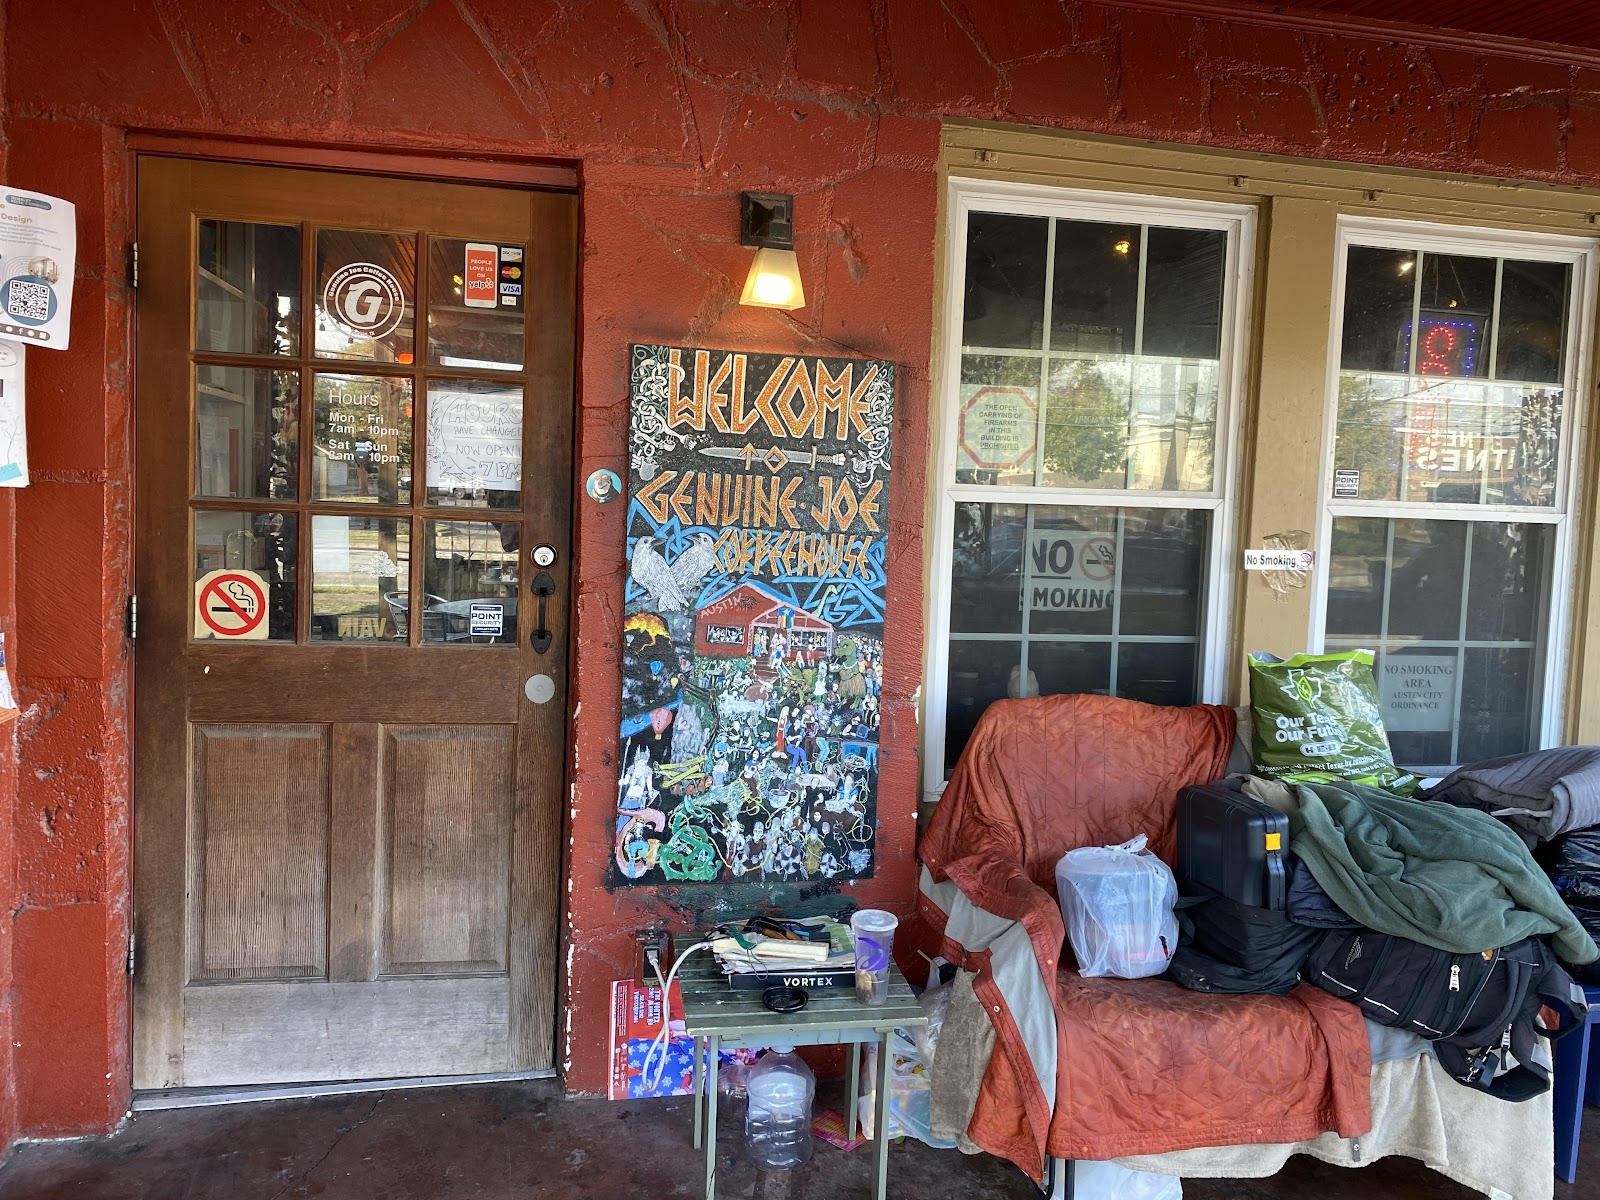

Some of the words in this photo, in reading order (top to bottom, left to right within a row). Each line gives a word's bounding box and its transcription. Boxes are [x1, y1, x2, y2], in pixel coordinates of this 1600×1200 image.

[1, 213, 33, 224] Design
[328, 271, 349, 297] Genuine
[348, 266, 362, 275] Joe
[363, 267, 387, 281] Coffee
[386, 278, 400, 301] House
[470, 280, 486, 289] yelp
[344, 280, 384, 323] G
[329, 389, 379, 406] Hours
[668, 348, 878, 441] WELCOME
[329, 412, 355, 423] Mon
[367, 414, 384, 424] Fri
[448, 403, 523, 425] HOURS
[328, 423, 355, 434] 7am
[368, 425, 399, 437] 10pm
[453, 426, 475, 435] HAVE
[328, 439, 350, 450] Sat
[366, 441, 388, 451] Sun
[456, 445, 480, 456] NOW
[485, 445, 515, 456] OPEN
[328, 450, 355, 461] 8am
[368, 453, 400, 465] 10pm
[737, 442, 789, 474] TO
[479, 461, 495, 477] 7
[495, 462, 522, 479] PM
[636, 470, 803, 528] GENUINE
[811, 476, 883, 532] JOE
[1030, 539, 1074, 574] NO
[1246, 554, 1258, 565] No
[1259, 554, 1296, 568] Smoking
[1384, 664, 1399, 674] NO
[1400, 665, 1453, 675] SMOKING
[1403, 679, 1432, 688] AREA
[1391, 691, 1421, 699] AUSTIN
[1423, 691, 1444, 699] CITY
[1275, 716, 1305, 729] Our
[1275, 730, 1305, 743] Our
[783, 977, 833, 987] VORTEX
[653, 1001, 661, 1024] VORTEX
